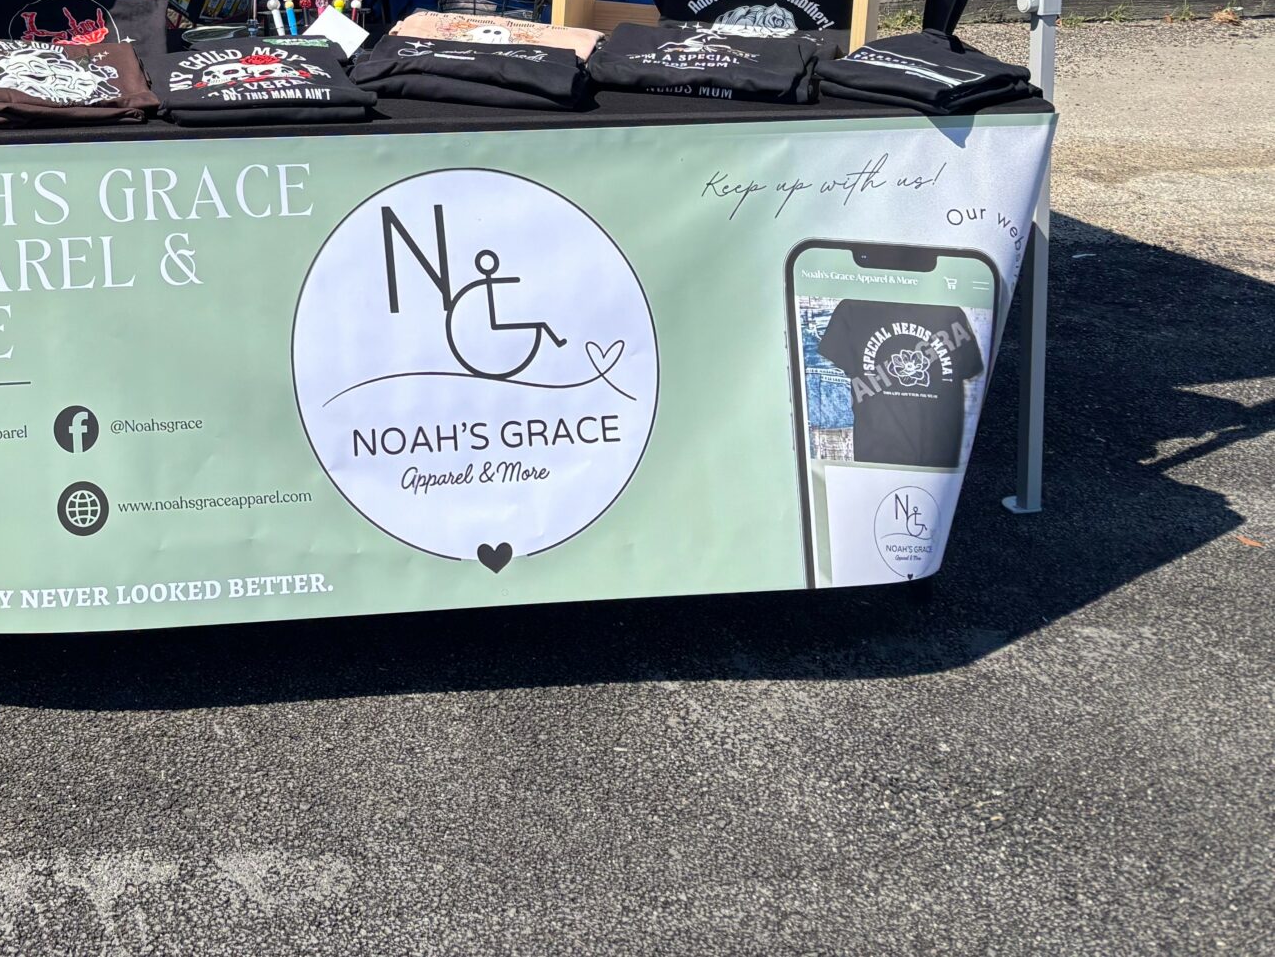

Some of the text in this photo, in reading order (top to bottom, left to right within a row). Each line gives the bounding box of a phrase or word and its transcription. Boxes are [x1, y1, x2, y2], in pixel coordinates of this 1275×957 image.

[179, 49, 243, 70] CHILD
[252, 46, 307, 61] MAY
[678, 53, 740, 64] SPECIAL
[169, 71, 194, 92] MY
[244, 92, 269, 100] THIS
[271, 89, 303, 99] MAMA
[305, 88, 331, 100] AIN'T
[98, 162, 314, 223] GRACE
[701, 153, 947, 220] Keep up with us!
[946, 208, 986, 226] Our
[159, 232, 204, 287] &
[801, 269, 918, 285] Noah's Grace Apparel & More
[863, 322, 953, 376] SPECIAL NEEDS MAMA
[110, 417, 203, 435] @Noahsgrace
[353, 414, 621, 457] NOAH'S GRACE
[401, 461, 550, 495] Apparel & More
[117, 490, 312, 514] www.noahsgraceapparel.com
[885, 544, 933, 554] NOAH'S GRACE
[20, 587, 111, 609] NEVER
[116, 580, 222, 606] LOOKED
[227, 572, 334, 598] BETTER.
